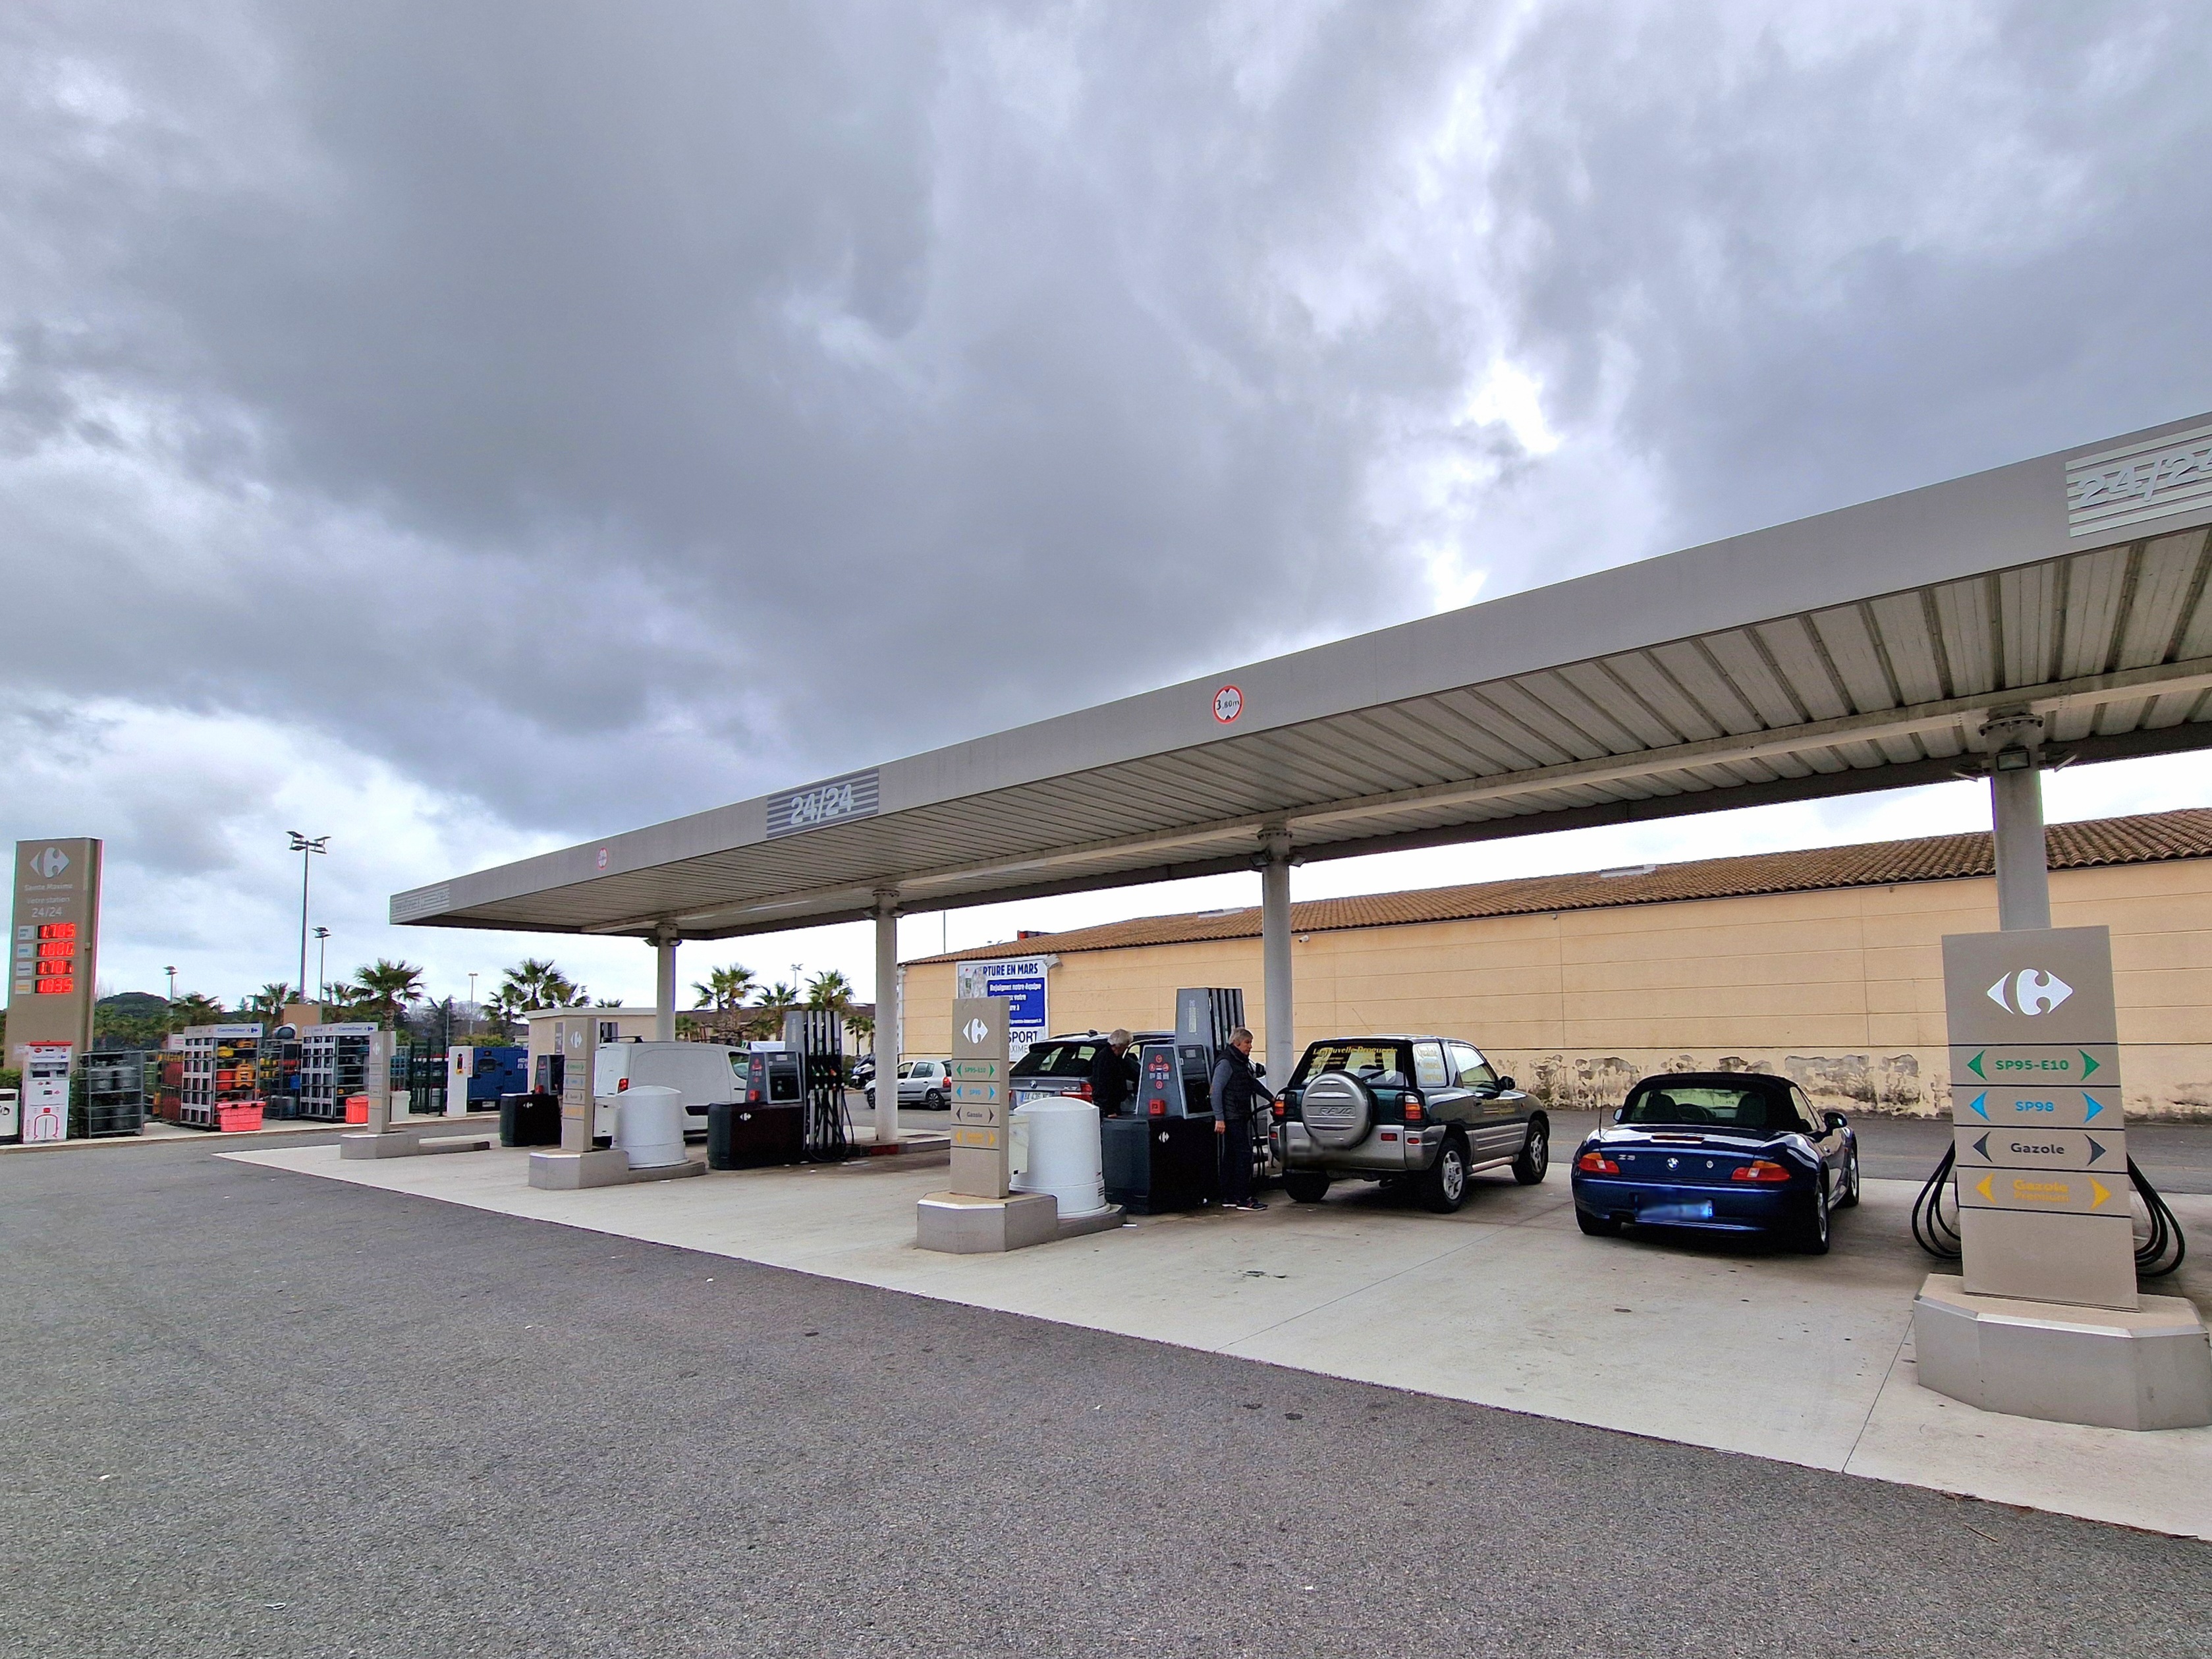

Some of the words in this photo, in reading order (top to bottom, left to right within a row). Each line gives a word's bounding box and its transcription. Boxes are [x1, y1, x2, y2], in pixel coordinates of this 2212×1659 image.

[790, 784, 854, 824] 24/24
[31, 907, 63, 918] 24/24
[983, 965, 1005, 976] RTURE
[1007, 965, 1016, 974] EN
[1018, 963, 1038, 974] MARS
[1995, 1059, 2070, 1071] SP95-E10
[2015, 1101, 2055, 1112] SP98
[2010, 1142, 2065, 1154] Gazole
[2013, 1179, 2069, 1193] Gazole
[2014, 1191, 2071, 1203] Premium
